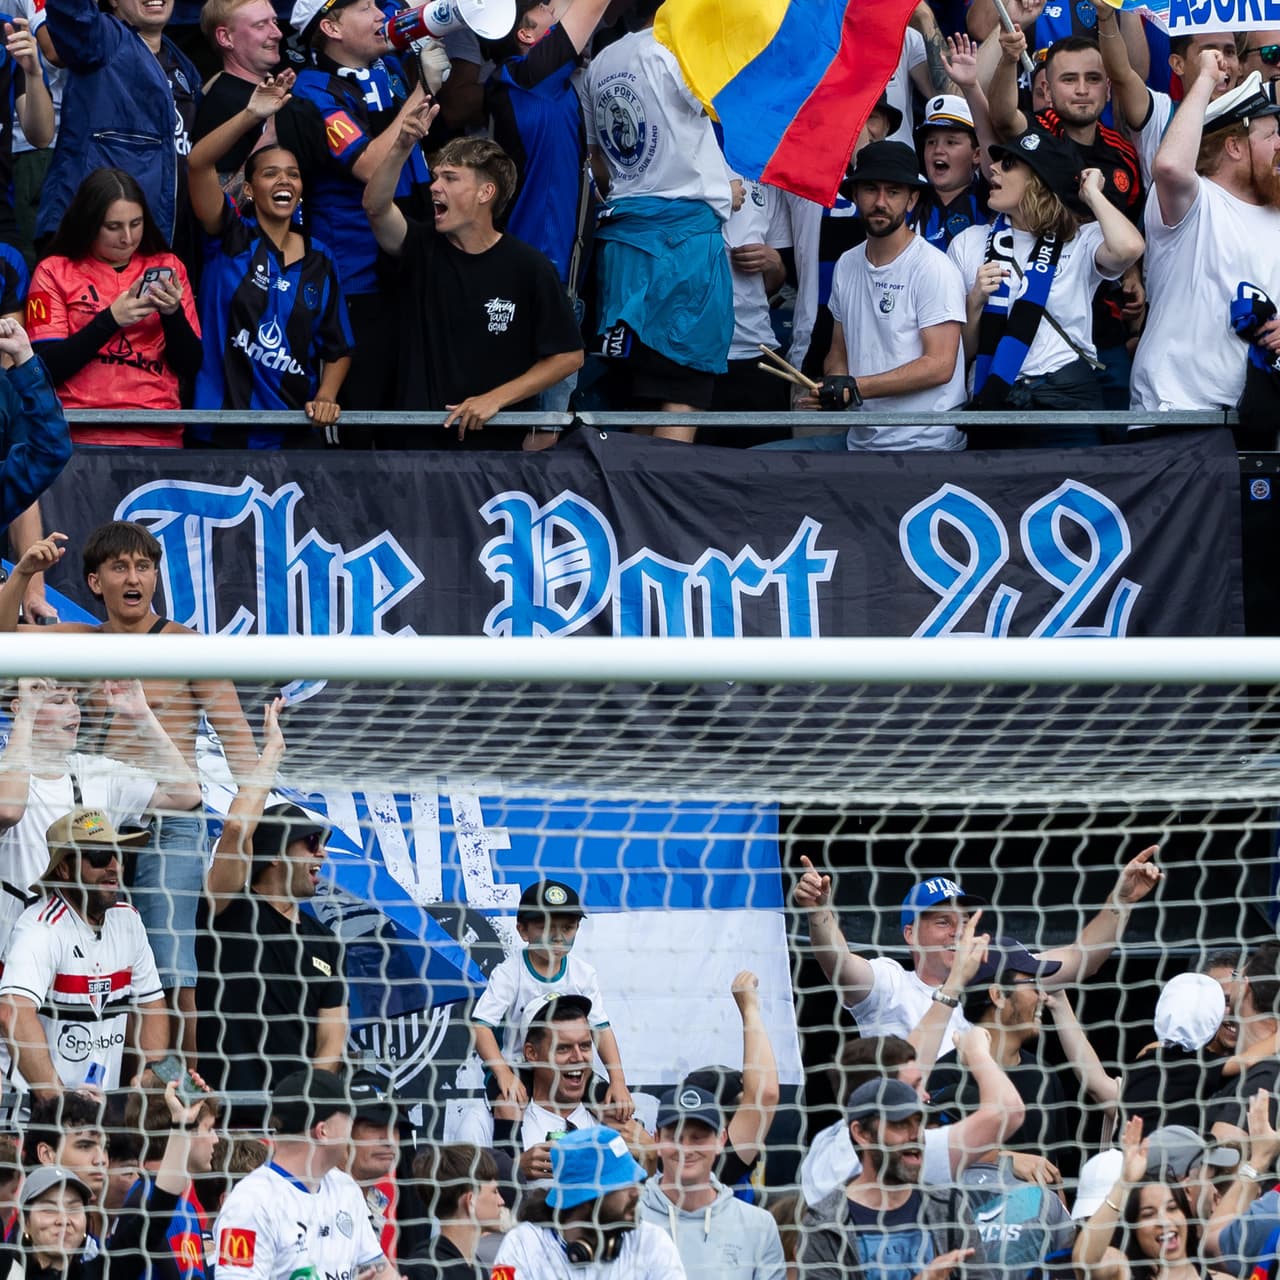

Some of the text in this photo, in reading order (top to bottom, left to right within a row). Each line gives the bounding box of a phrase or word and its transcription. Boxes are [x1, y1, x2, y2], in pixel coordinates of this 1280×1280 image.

[597, 72, 629, 89] AUCKLAND
[598, 85, 637, 109] THE PORT
[646, 124, 659, 158] ISLAND
[1035, 244, 1054, 273] OUR
[888, 283, 905, 291] PORT
[114, 475, 1144, 637] The Port 22
